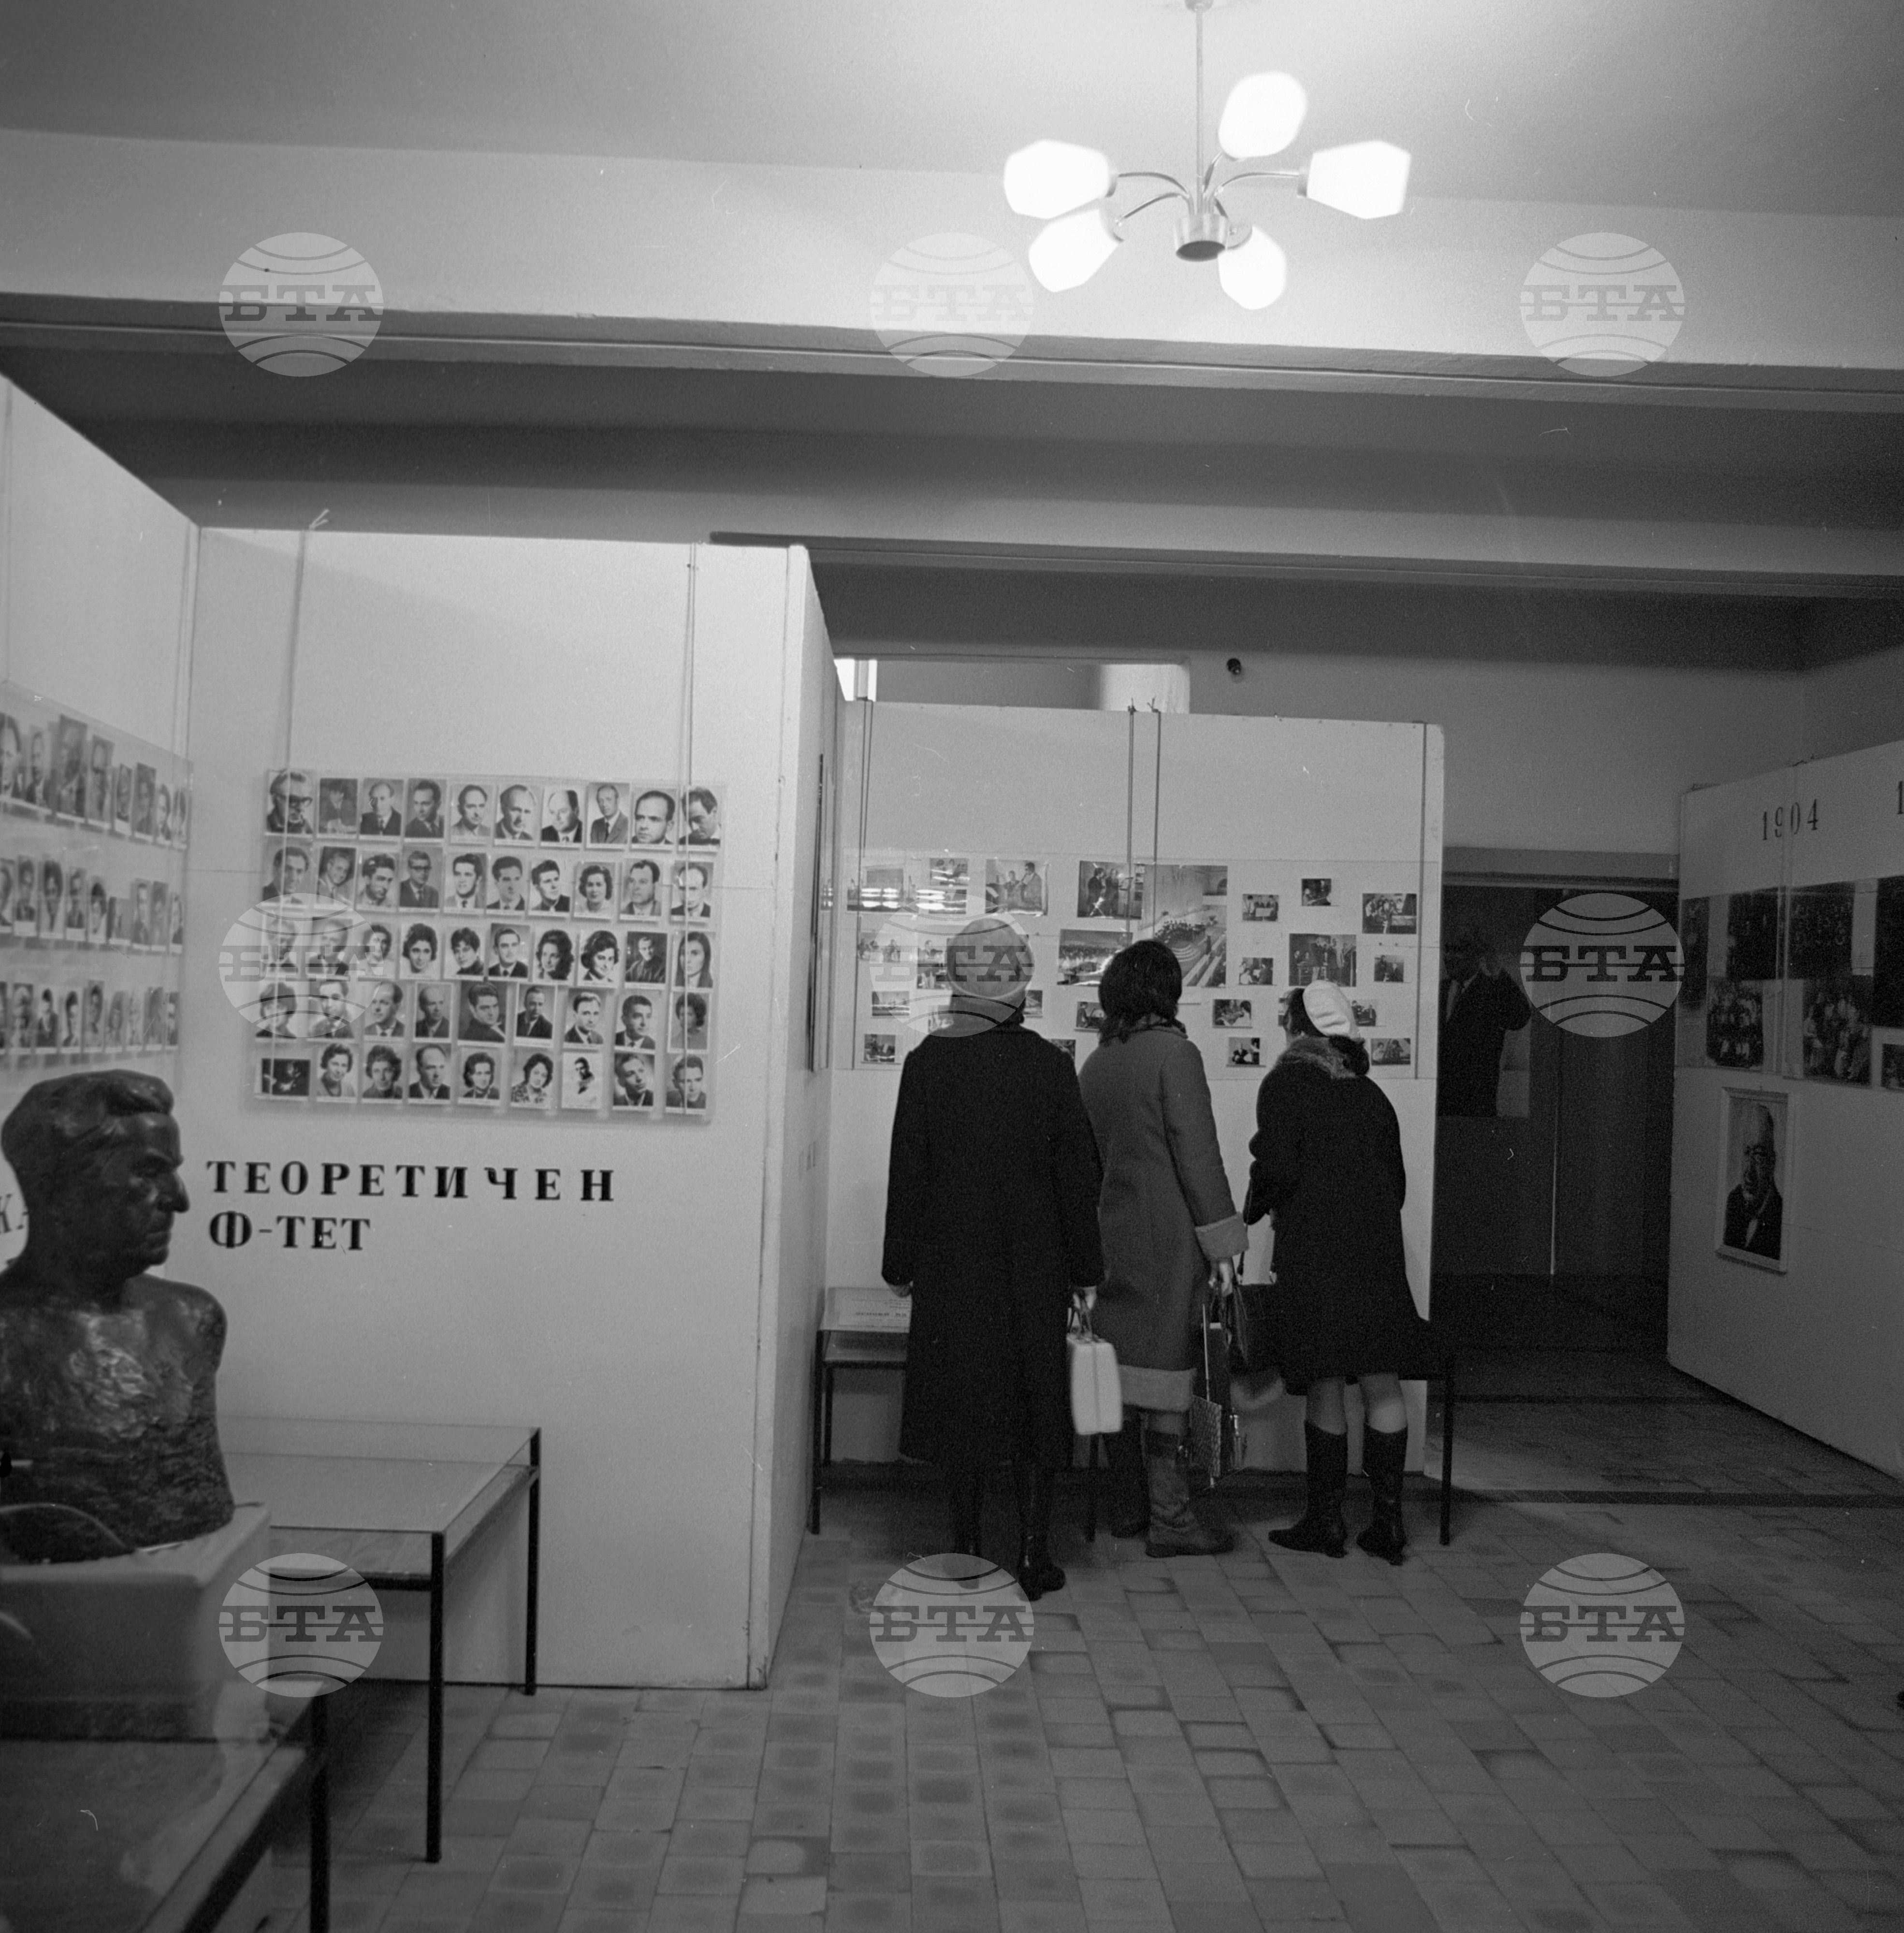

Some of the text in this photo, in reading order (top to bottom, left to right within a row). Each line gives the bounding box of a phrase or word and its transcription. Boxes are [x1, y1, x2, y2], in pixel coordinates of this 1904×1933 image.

[1762, 799, 1818, 840] 1904
[206, 1160, 614, 1201] ТЕОРЕТИЧЕН
[209, 1211, 371, 1251] Ф-ТЕТ
